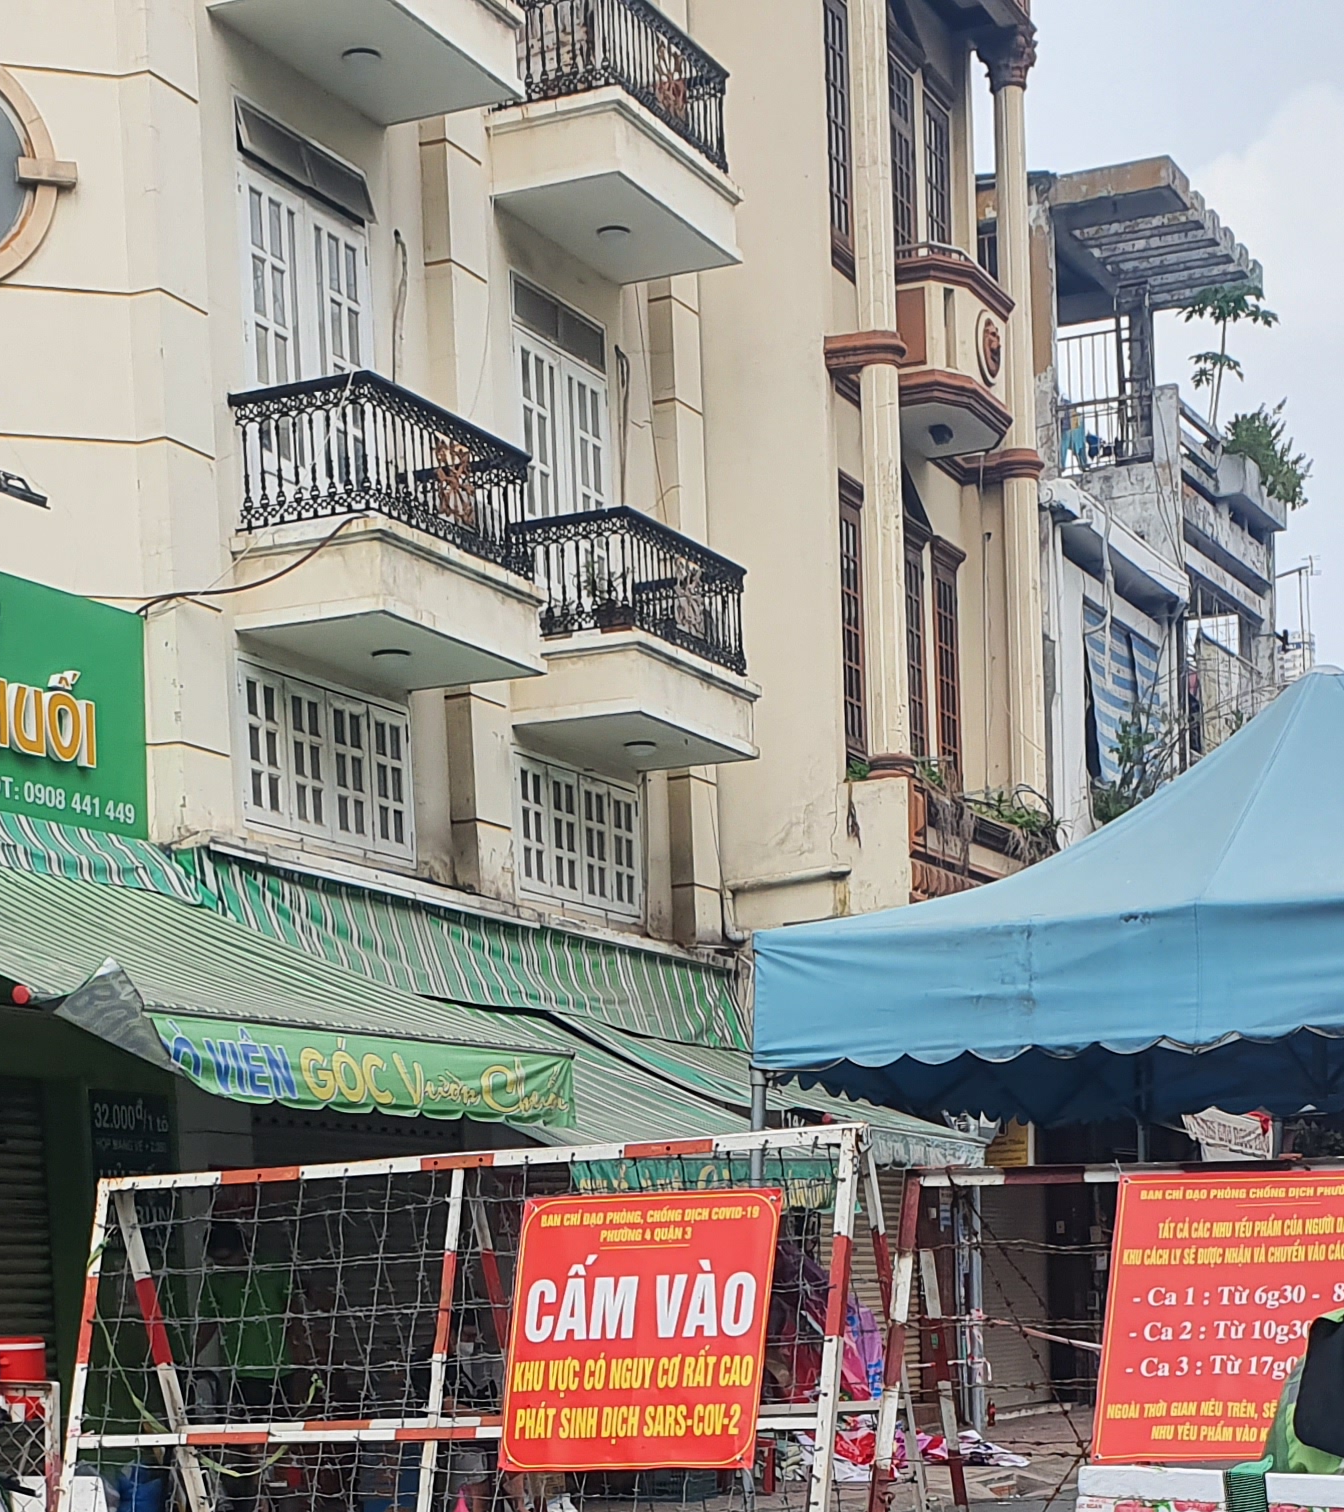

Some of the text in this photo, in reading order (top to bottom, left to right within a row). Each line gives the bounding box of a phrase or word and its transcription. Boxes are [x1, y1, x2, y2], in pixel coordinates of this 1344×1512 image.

[24, 782, 66, 810] 0908
[71, 792, 101, 818] 441
[105, 798, 136, 825] 449
[203, 1027, 299, 1100] VIÊN
[299, 1037, 397, 1105] GÓC
[1140, 1189, 1163, 1200] BAN
[1211, 1187, 1247, 1199] PHÒNG
[1249, 1184, 1286, 1199] CHỐNG
[1288, 1186, 1314, 1200] DỊCH
[541, 1214, 561, 1228] BAN
[606, 1209, 644, 1225] PHÒNG,
[647, 1206, 681, 1223] CHỐNG
[684, 1207, 709, 1224] DỊCH
[711, 1205, 760, 1221] COVID-19
[1158, 1216, 1175, 1239] TẤT
[1176, 1216, 1190, 1239] CẢ
[1191, 1217, 1211, 1239] CÁC
[1212, 1221, 1232, 1238] NHU
[1284, 1213, 1303, 1237] CỦA
[1305, 1213, 1334, 1237] NGƯỜI
[599, 1225, 693, 1243] PHƯỜNG 4 QUẬN 3
[1123, 1248, 1143, 1265] KHU
[1144, 1245, 1169, 1265] CÁCH
[1170, 1248, 1182, 1265] LY
[1253, 1243, 1266, 1263] VÀ
[1308, 1241, 1326, 1261] VÀO
[523, 1254, 757, 1343] CẤM VÀO
[1147, 1282, 1306, 1309] Ca 1 Từ 6g30
[1144, 1317, 1247, 1342] Ca 2 Từ
[513, 1345, 754, 1398] KHU VỰC CÓ NGUY CƠ RẤT CAO
[1140, 1354, 1243, 1377] Ca 3 Từ
[1106, 1400, 1140, 1419] NGOÀI
[1144, 1399, 1167, 1418] THỜI
[1170, 1401, 1197, 1416] GIAN
[515, 1401, 742, 1445] PHÁT SINH DỊCH SARS-COV-2
[1151, 1425, 1175, 1440] NHU
[1236, 1424, 1258, 1442] VÀO
